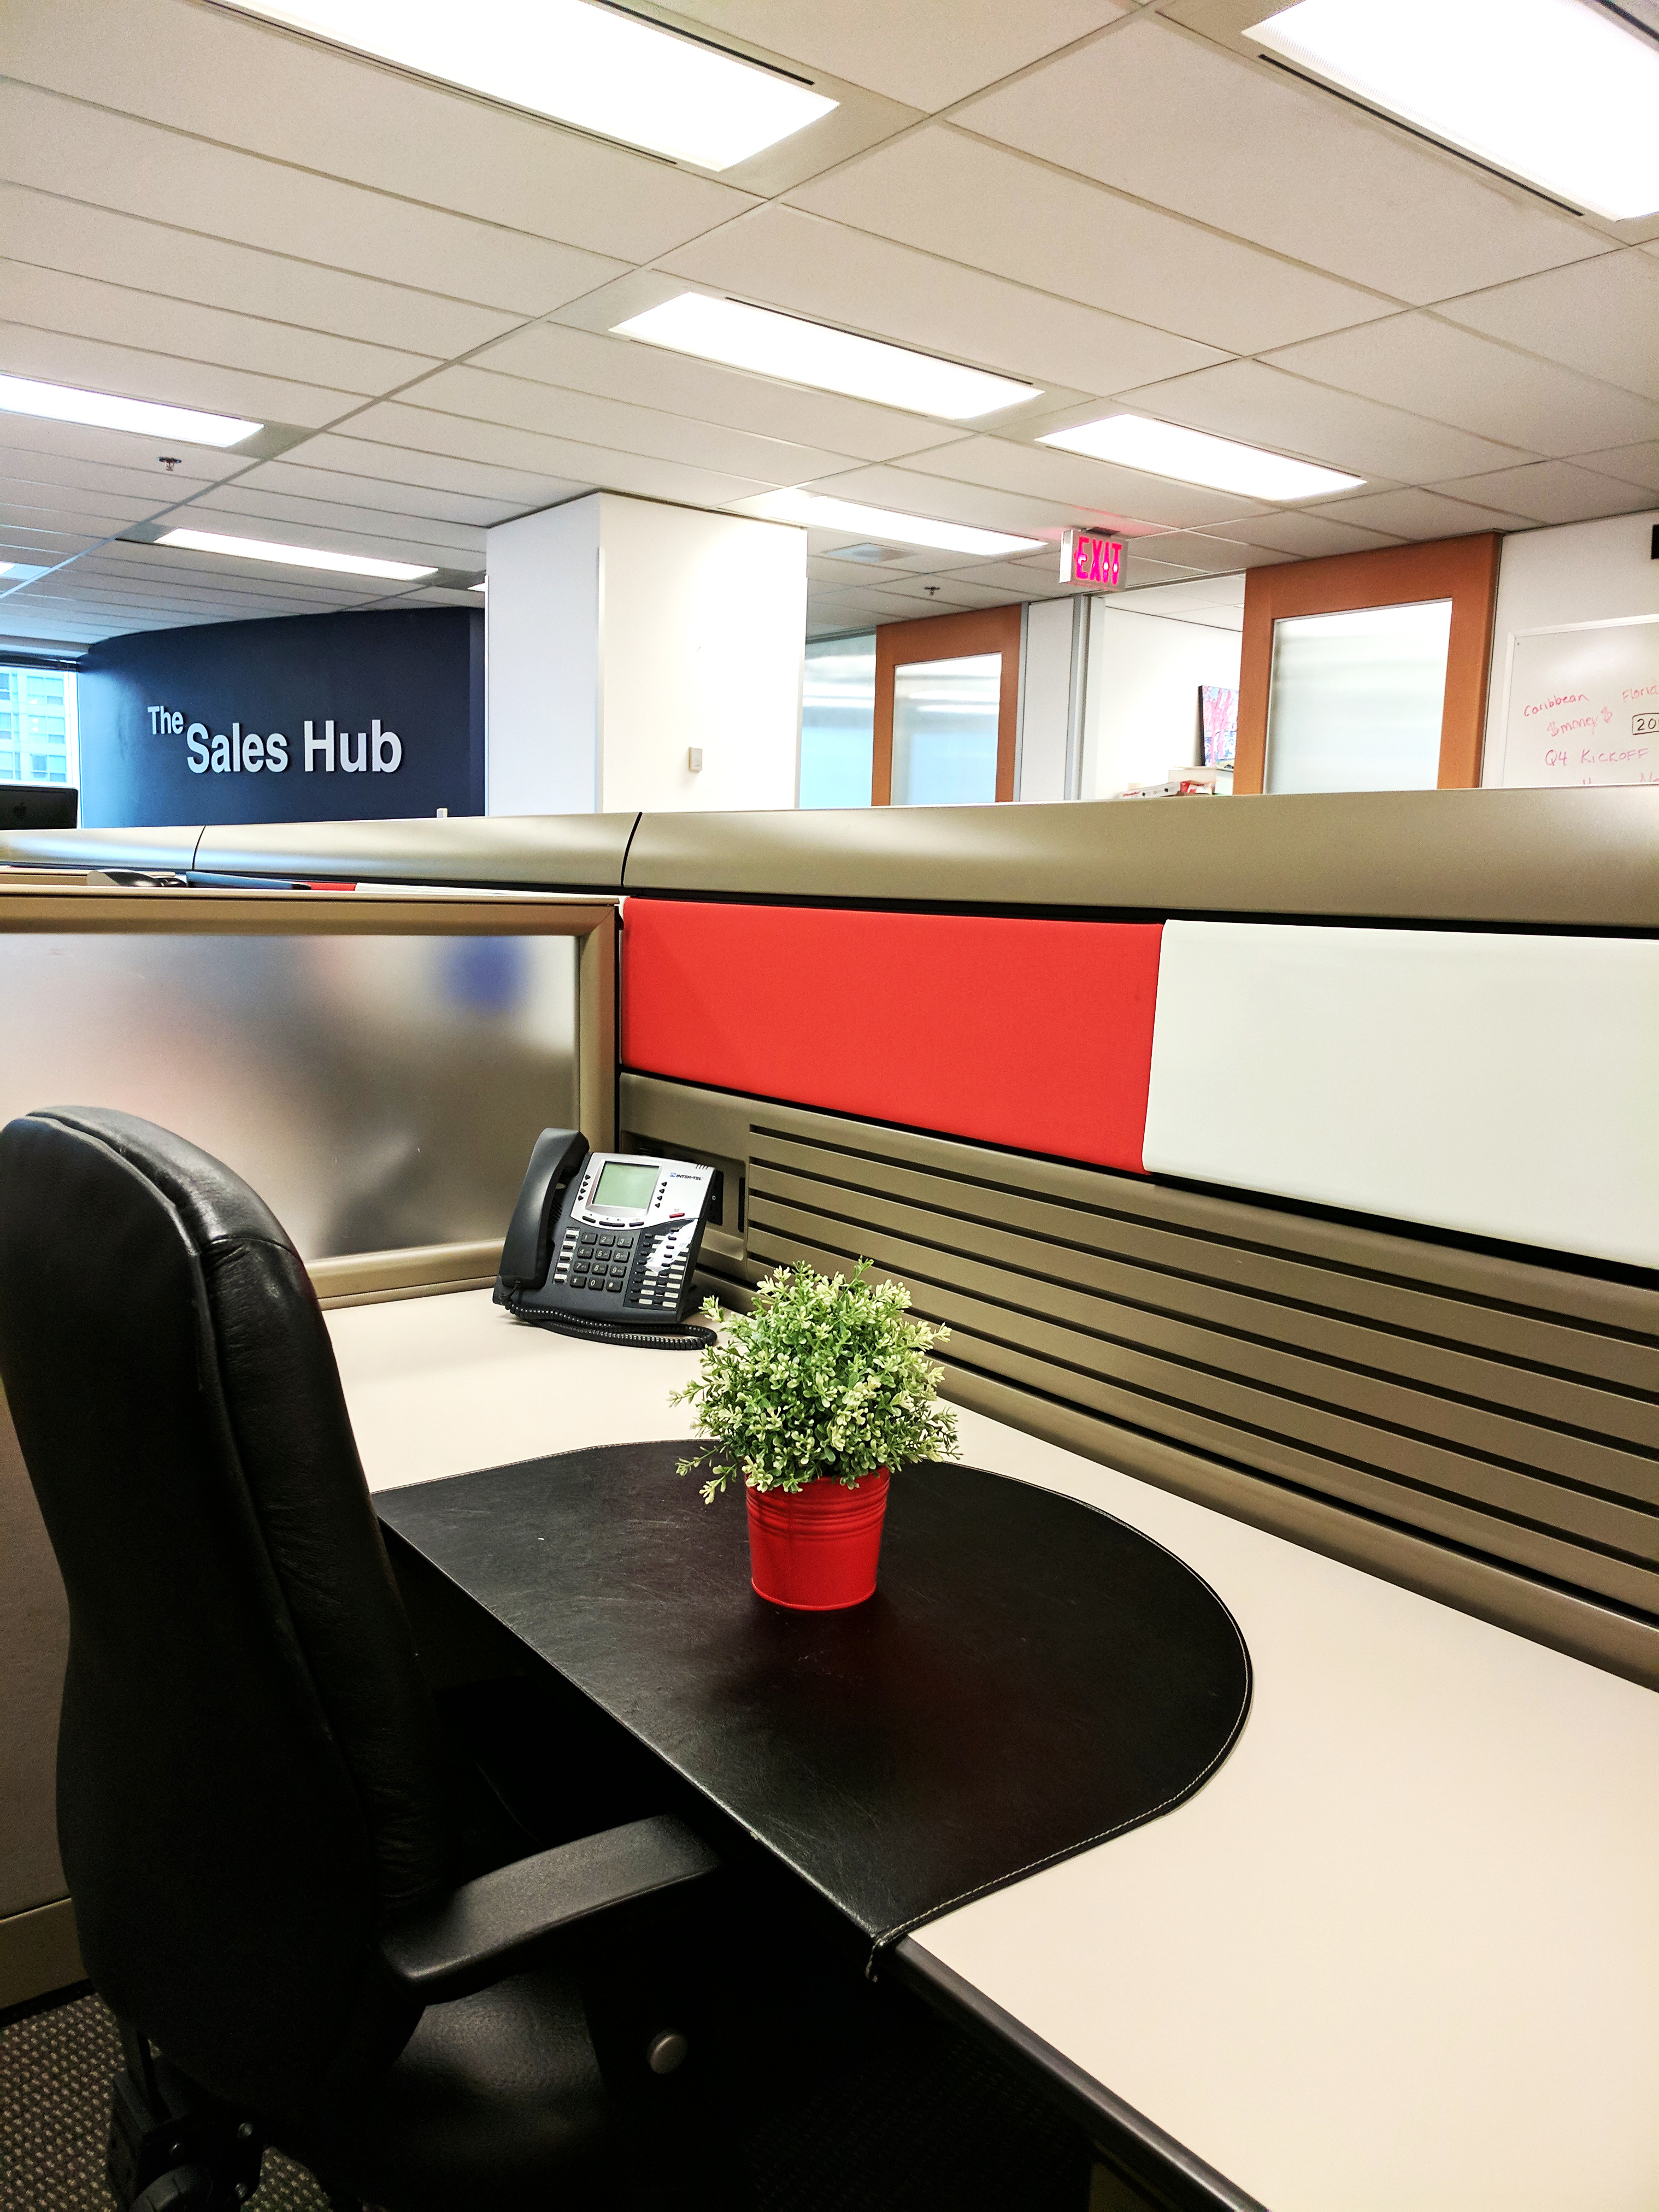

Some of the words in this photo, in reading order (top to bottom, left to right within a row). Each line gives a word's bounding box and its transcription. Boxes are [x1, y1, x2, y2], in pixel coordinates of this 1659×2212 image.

[1076, 536, 1122, 585] EXIT
[1524, 693, 1590, 717] Caribbean
[1637, 718, 1659, 731] 20
[148, 705, 184, 735] The
[186, 722, 289, 774] Sales
[304, 719, 402, 773] Hub
[1545, 749, 1567, 766] Q4
